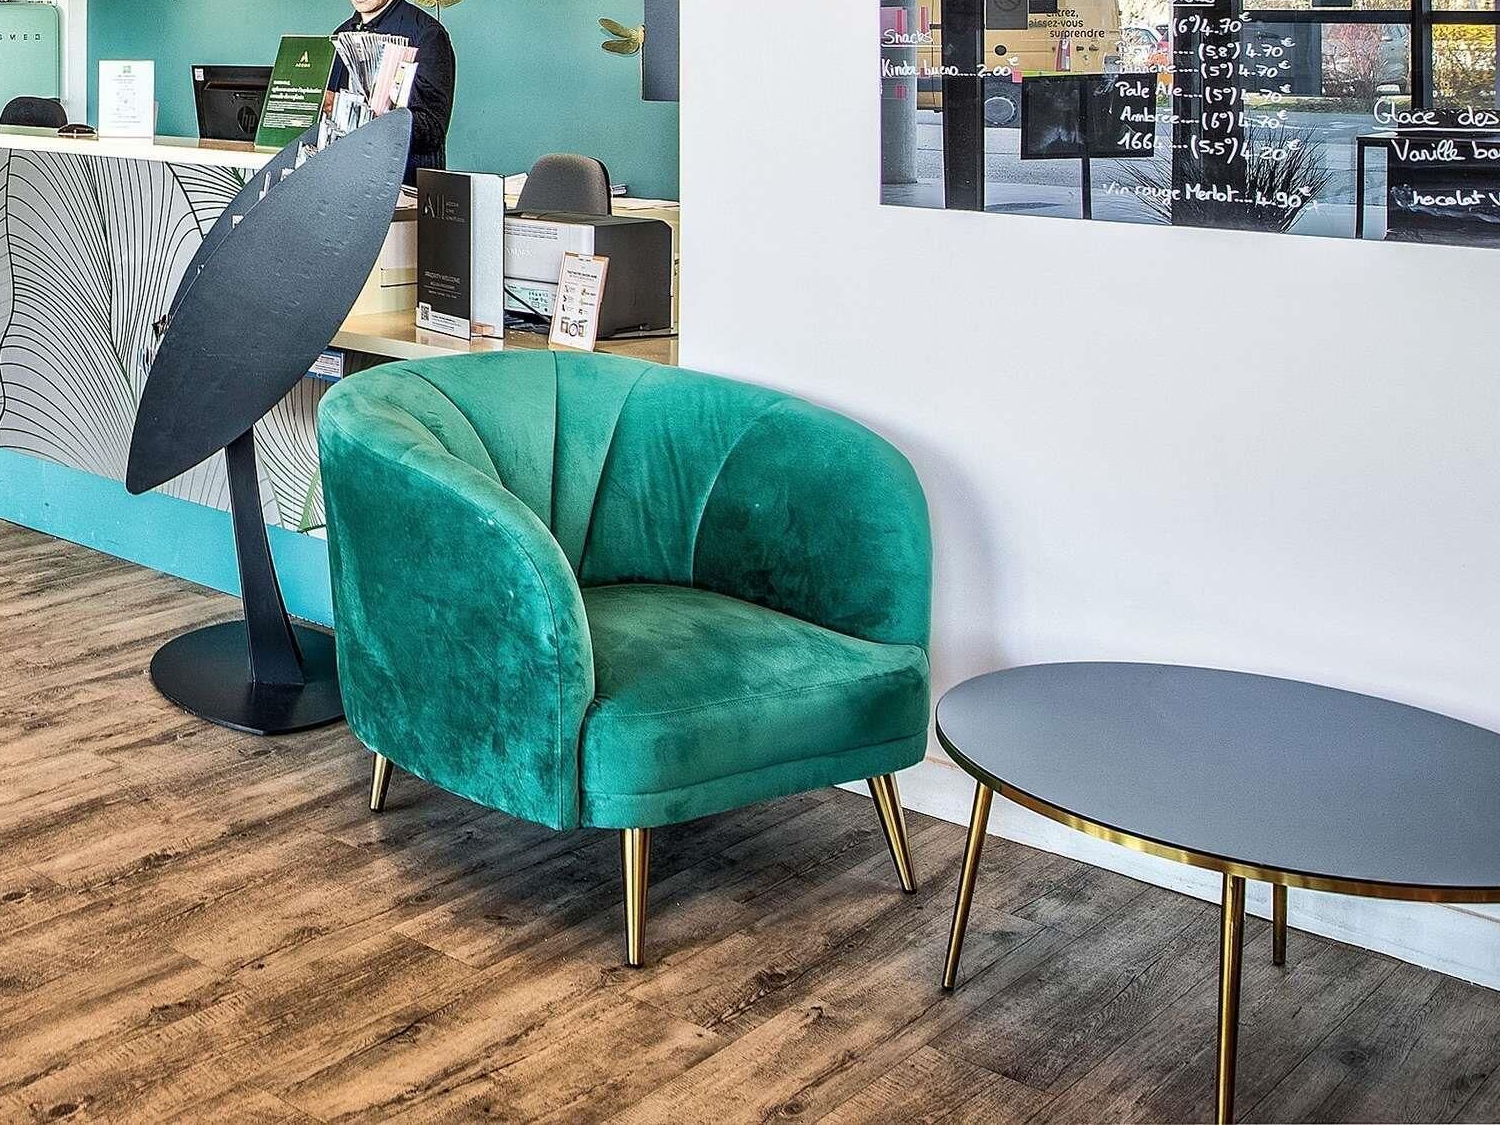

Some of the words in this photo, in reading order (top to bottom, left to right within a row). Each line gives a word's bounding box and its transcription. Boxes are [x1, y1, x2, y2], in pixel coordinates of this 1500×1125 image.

[883, 29, 934, 45] Snacks
[1049, 28, 1105, 40] surprendre
[1115, 81, 1151, 99] Pale
[1154, 81, 1184, 96] Ale
[1373, 99, 1440, 125] Glace
[1457, 105, 1500, 127] des
[1391, 138, 1467, 163] Vanille
[1185, 183, 1240, 203] Merlot
